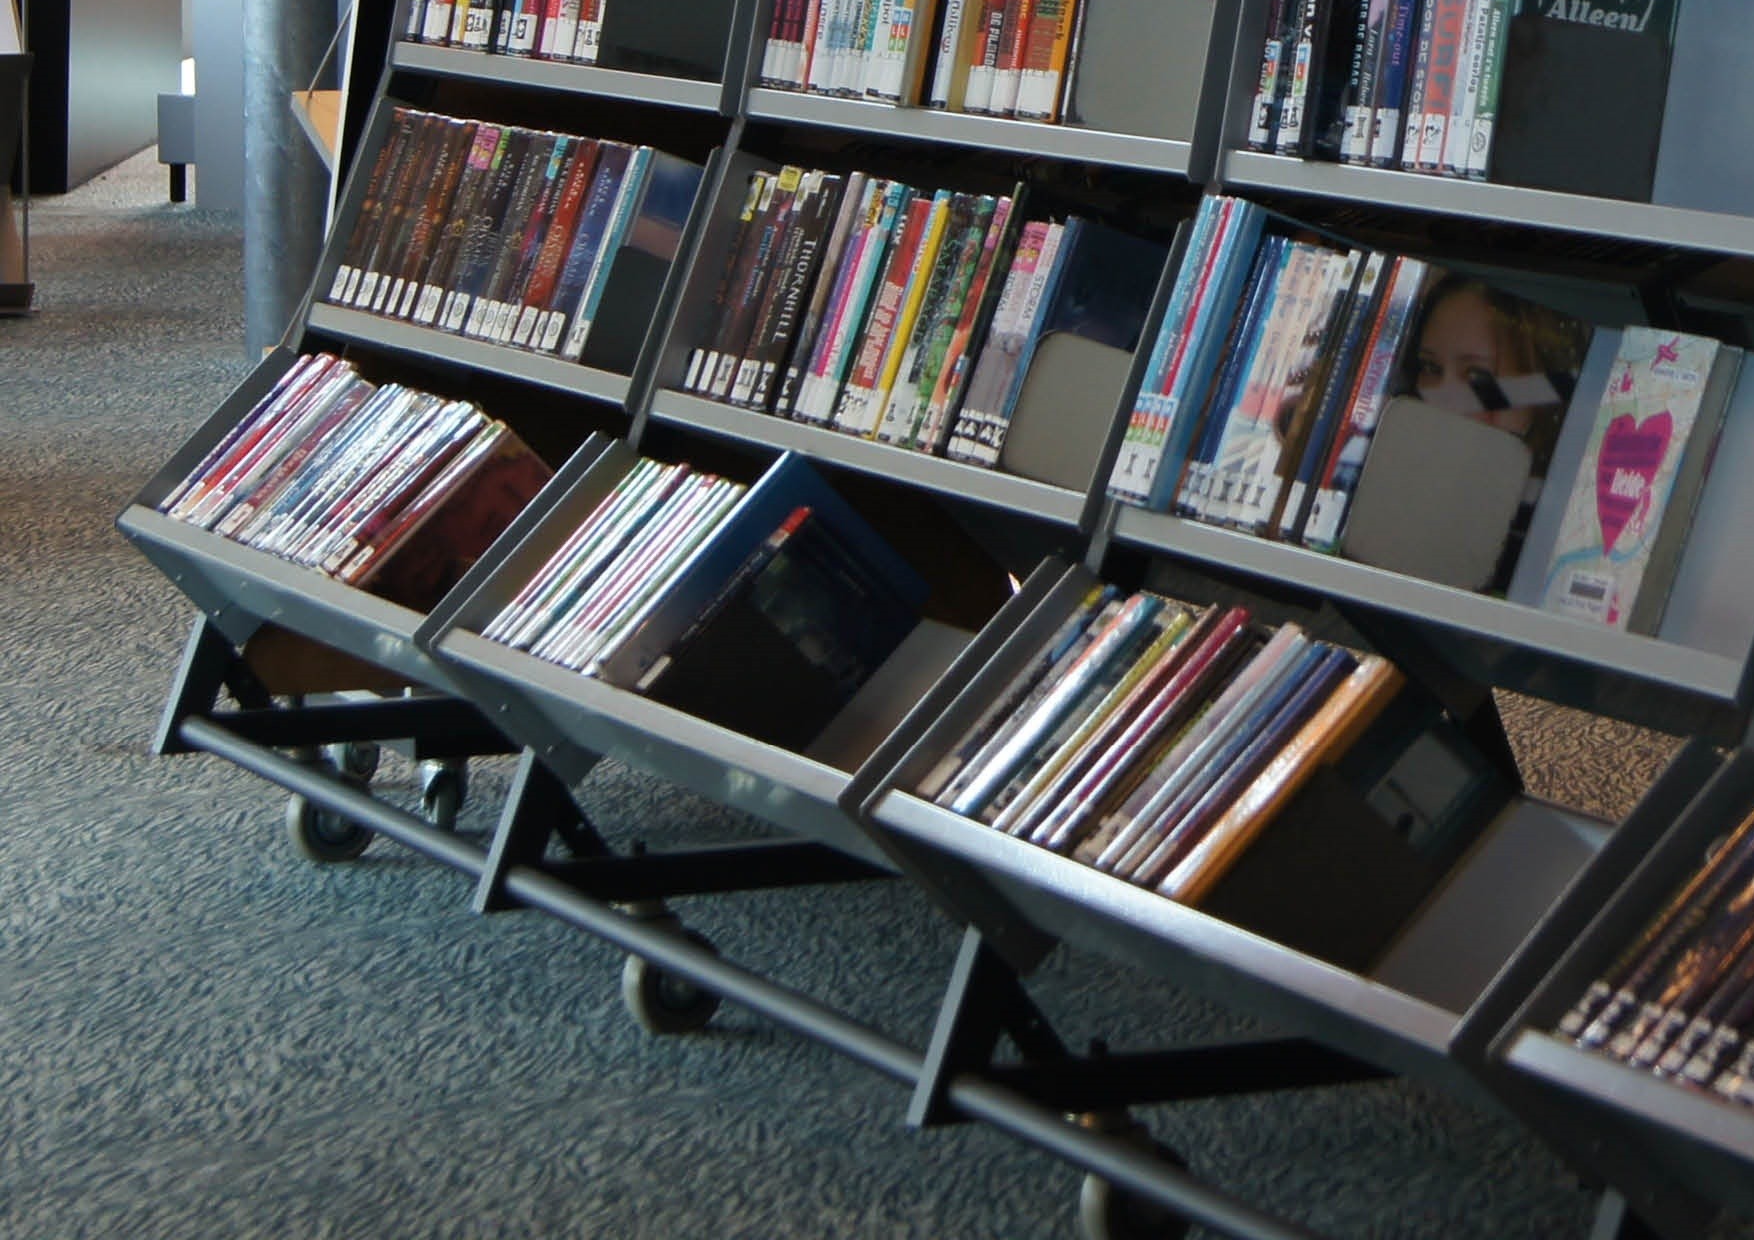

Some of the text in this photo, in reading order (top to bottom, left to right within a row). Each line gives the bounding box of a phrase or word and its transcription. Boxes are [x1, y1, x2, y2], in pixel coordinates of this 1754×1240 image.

[1391, 2, 1409, 65] Time-out
[1472, 6, 1491, 50] Patatje
[1466, 53, 1483, 94] oorlog
[770, 237, 819, 345] THORNHILL
